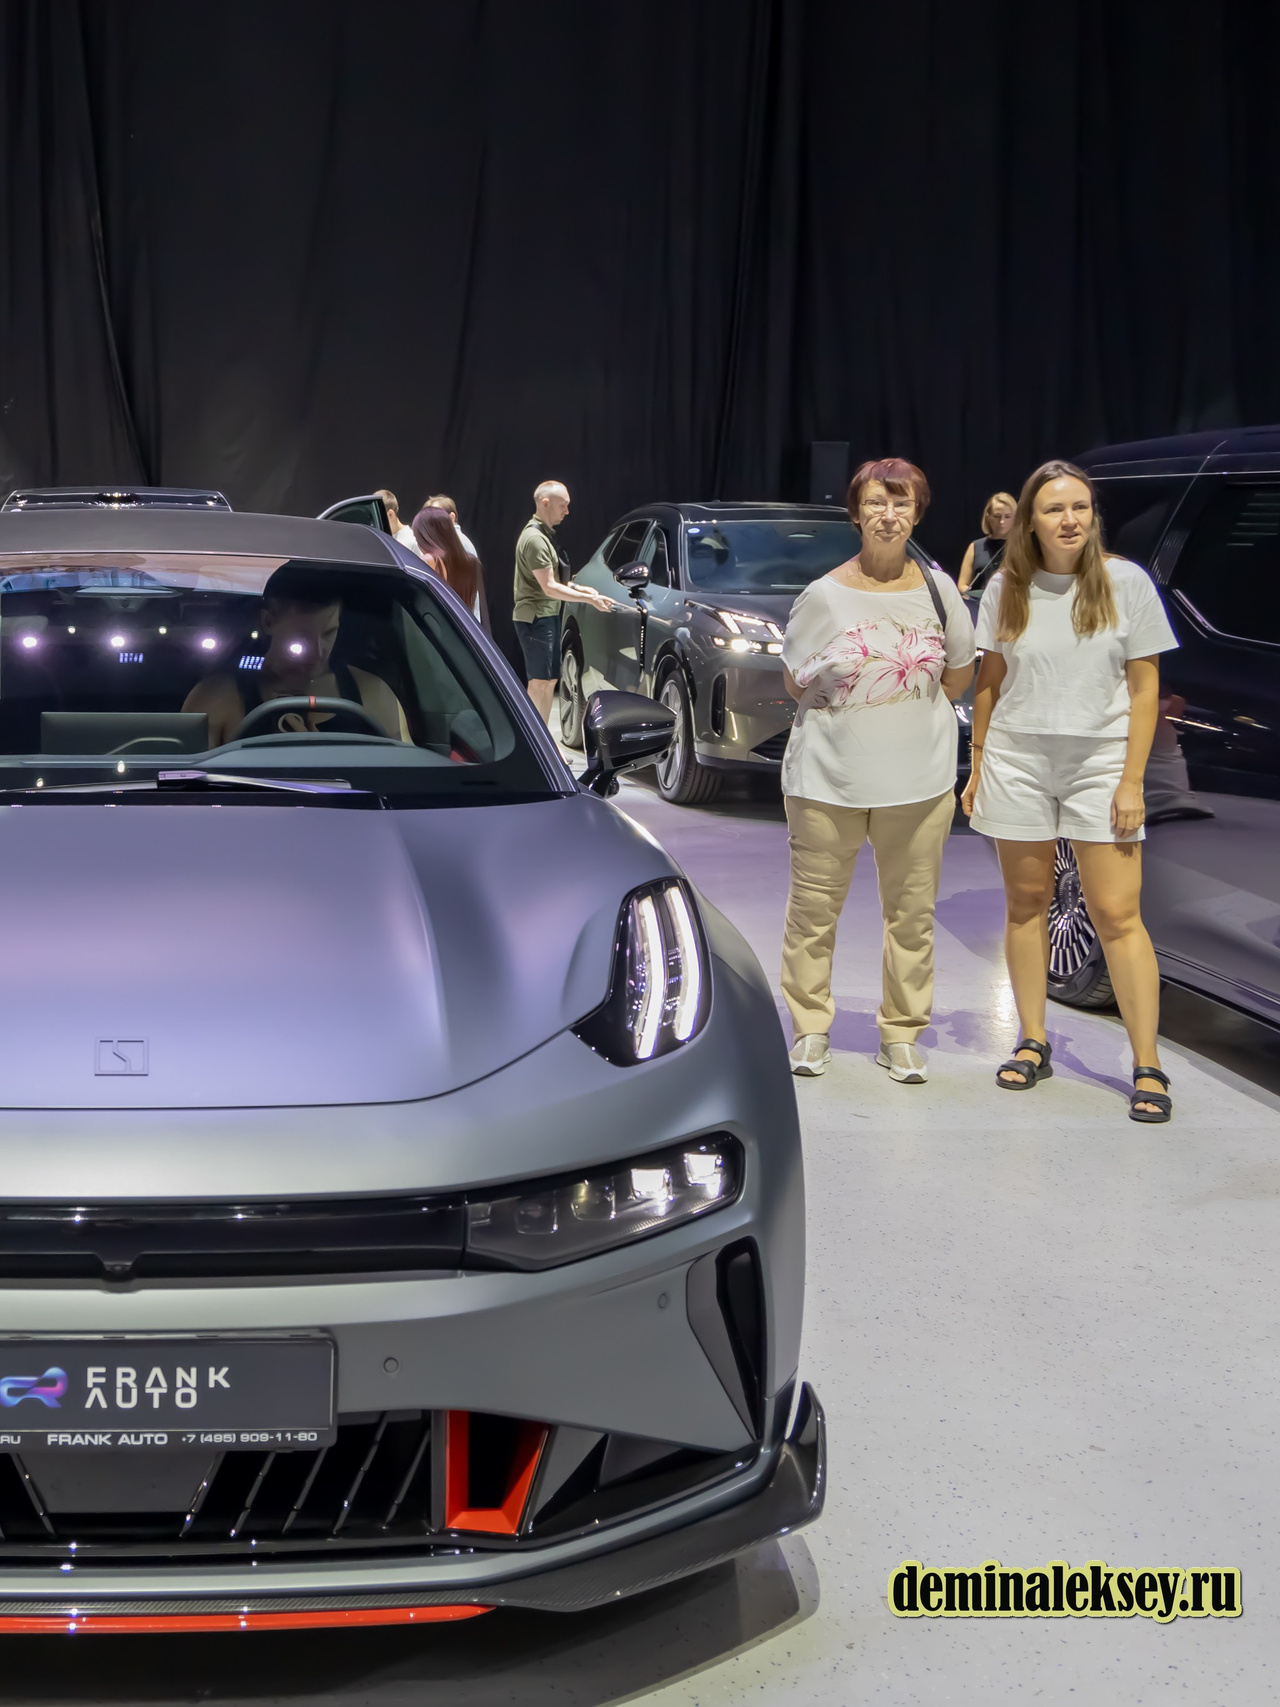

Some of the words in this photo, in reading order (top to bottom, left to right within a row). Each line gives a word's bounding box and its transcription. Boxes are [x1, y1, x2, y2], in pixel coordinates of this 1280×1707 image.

[86, 1366, 231, 1389] FRANK
[84, 1387, 198, 1409] AUTO
[47, 1433, 112, 1446] FRANK
[118, 1433, 168, 1445] AUTO
[181, 1434, 196, 1444] +7
[200, 1433, 236, 1443] (495)
[240, 1432, 318, 1443] 909-11-80
